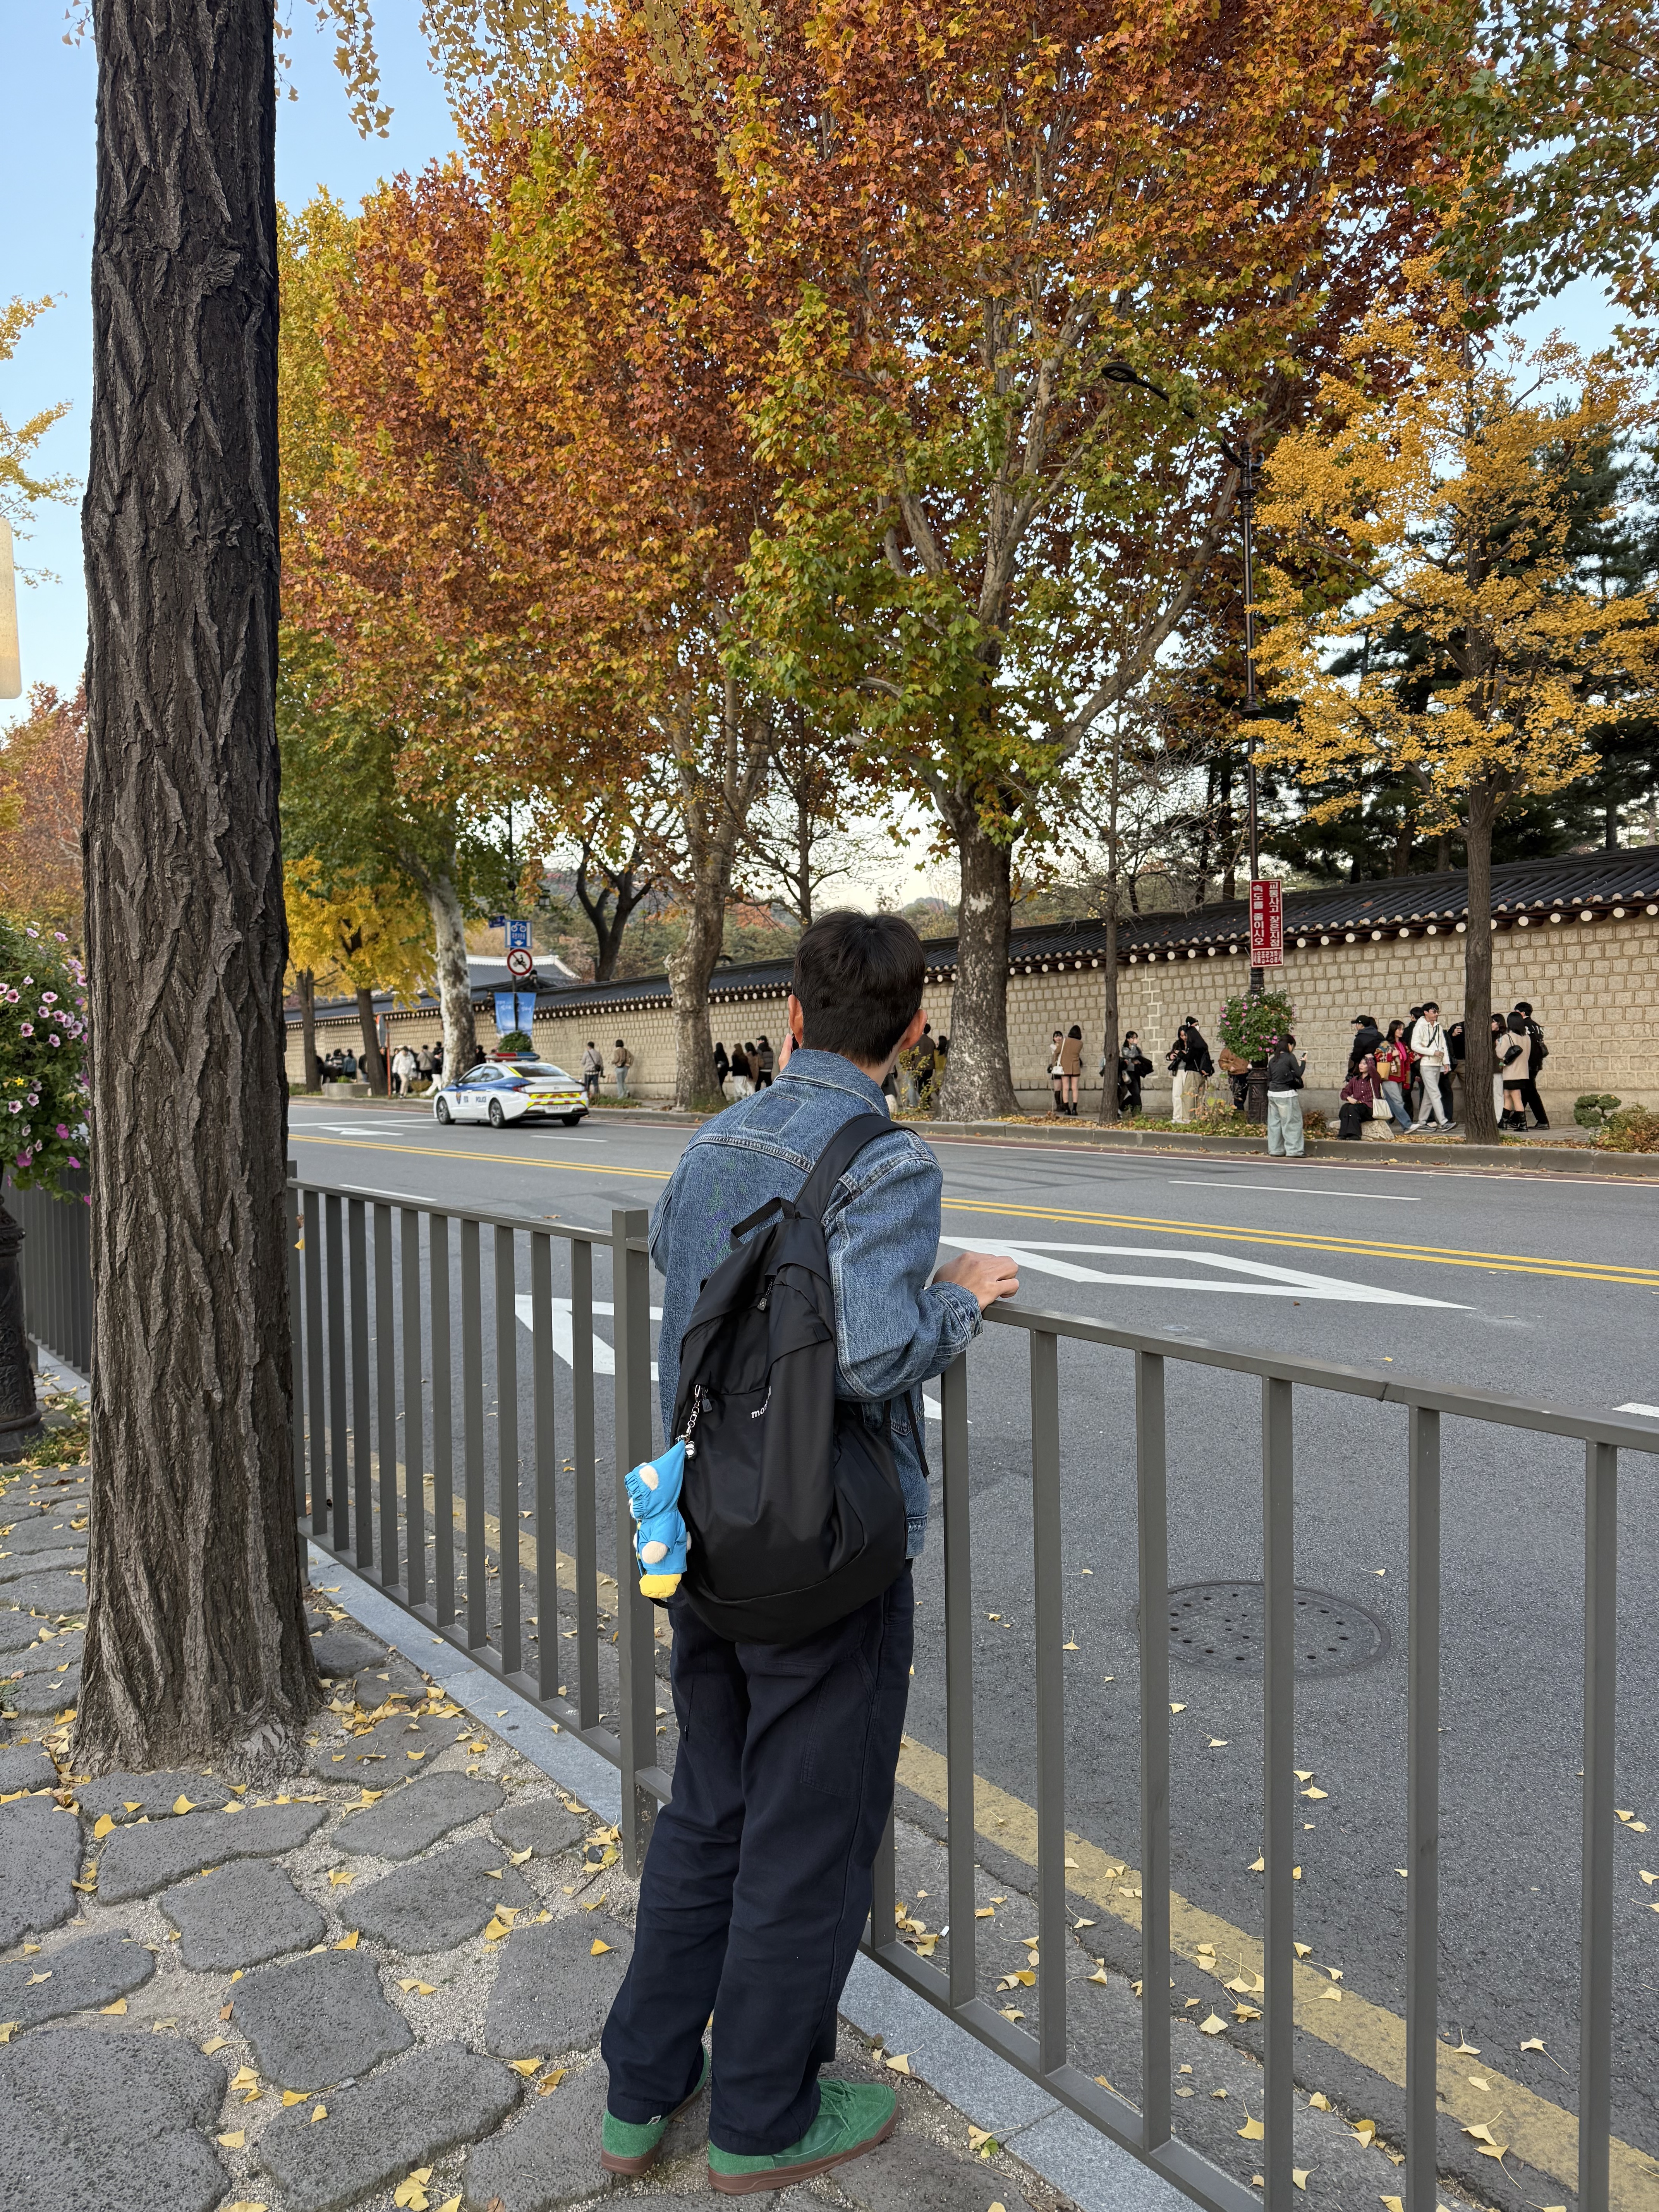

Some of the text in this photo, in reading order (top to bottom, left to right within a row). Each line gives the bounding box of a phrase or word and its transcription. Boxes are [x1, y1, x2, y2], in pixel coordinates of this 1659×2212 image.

[1253, 885, 1264, 946] 속도를 줄이시오
[1269, 882, 1280, 947] 교통사고 잦은지점
